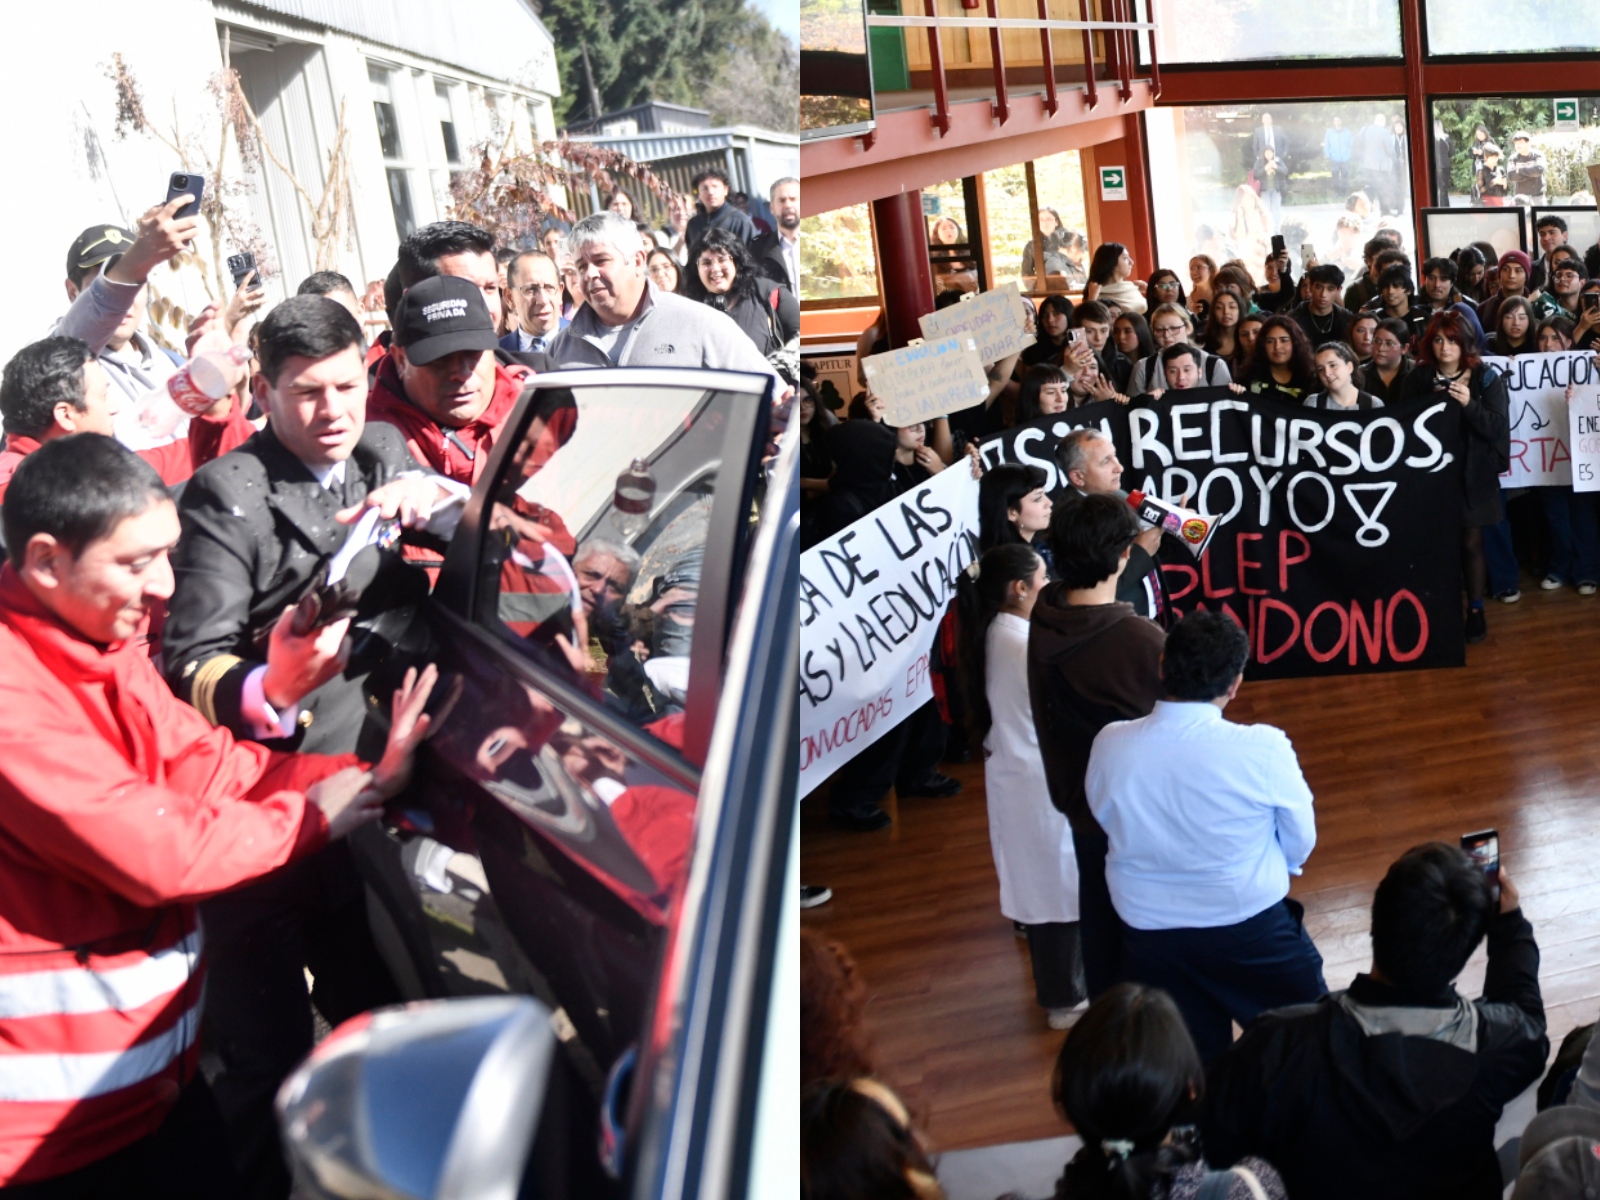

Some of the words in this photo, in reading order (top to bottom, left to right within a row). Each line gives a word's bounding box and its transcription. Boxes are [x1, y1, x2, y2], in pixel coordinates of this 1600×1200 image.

[422, 299, 468, 315] SEGURIDAD
[1129, 400, 1453, 476] RECURSOS,
[1498, 437, 1571, 477] RTA
[1579, 464, 1594, 481] ES
[819, 531, 880, 598] DE
[875, 488, 953, 561] LAS
